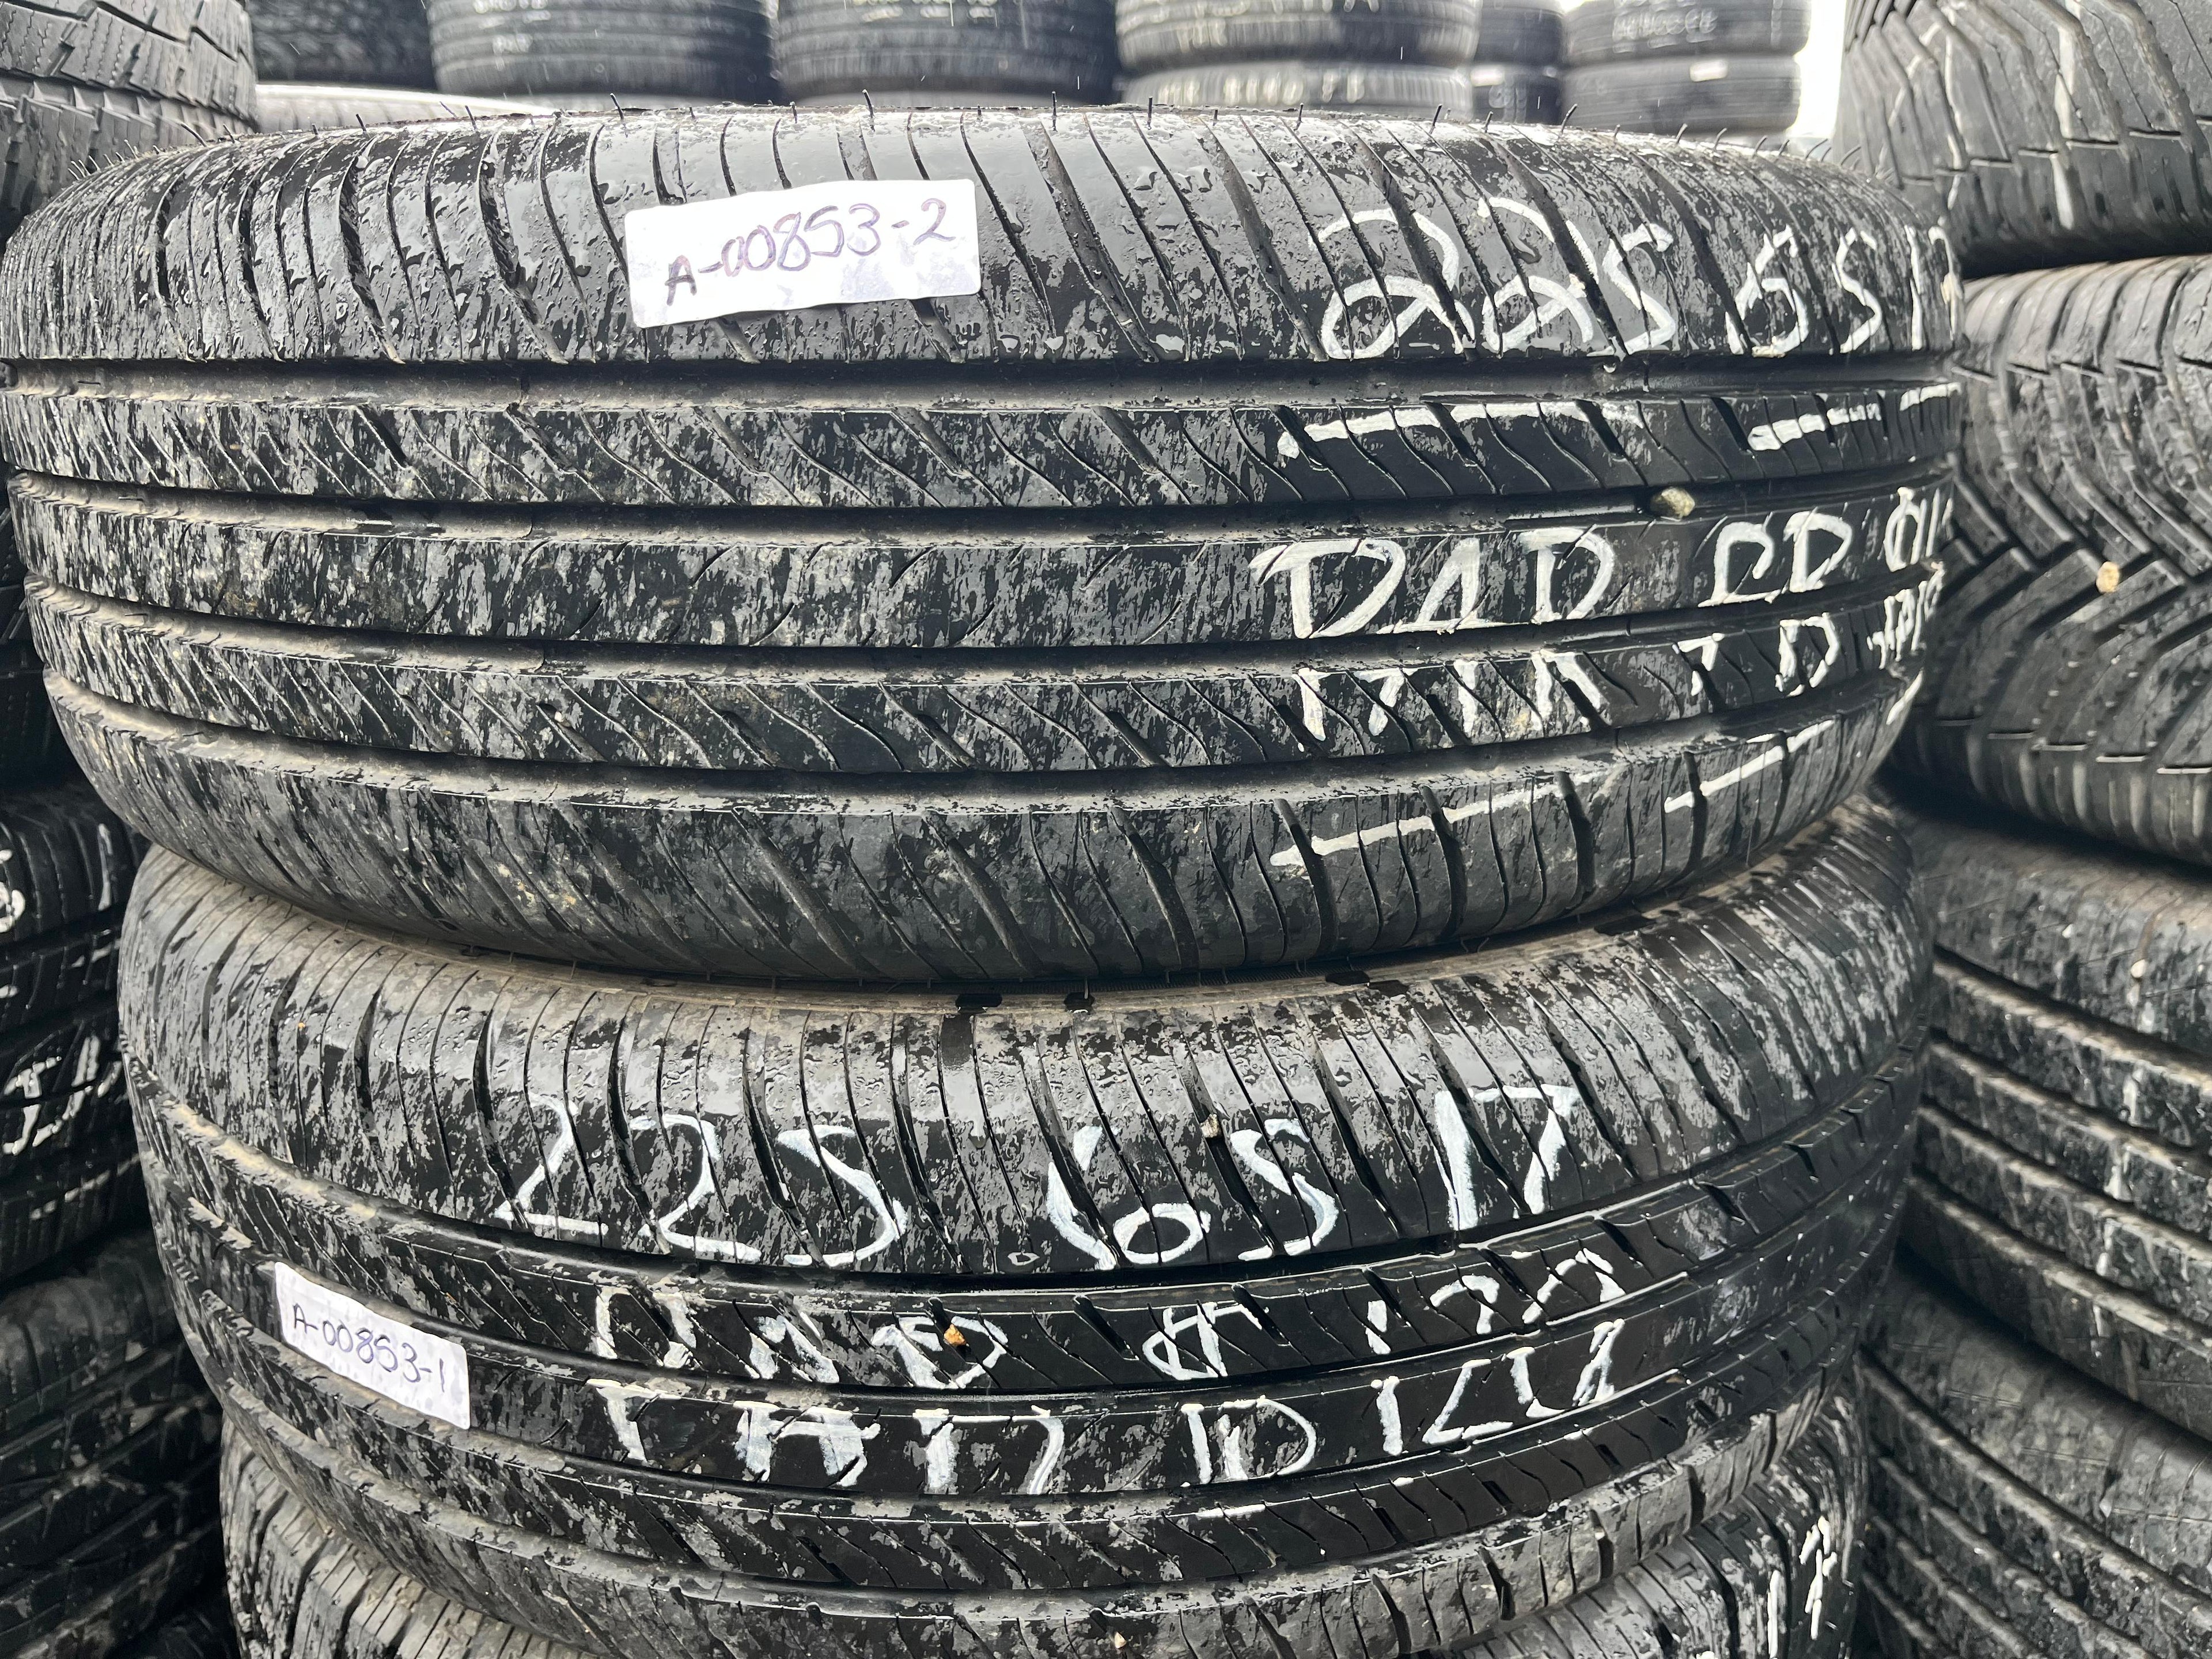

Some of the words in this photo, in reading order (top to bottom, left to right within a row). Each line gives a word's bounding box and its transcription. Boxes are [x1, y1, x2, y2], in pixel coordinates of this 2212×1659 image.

[664, 197, 956, 306] A-00853-2
[1310, 196, 1675, 359] 225
[1726, 224, 1883, 358] 65
[494, 1093, 907, 1267] 225
[1047, 1119, 1339, 1270] 65
[1434, 1083, 1579, 1230] 17
[293, 1303, 445, 1393] A-00853-1
